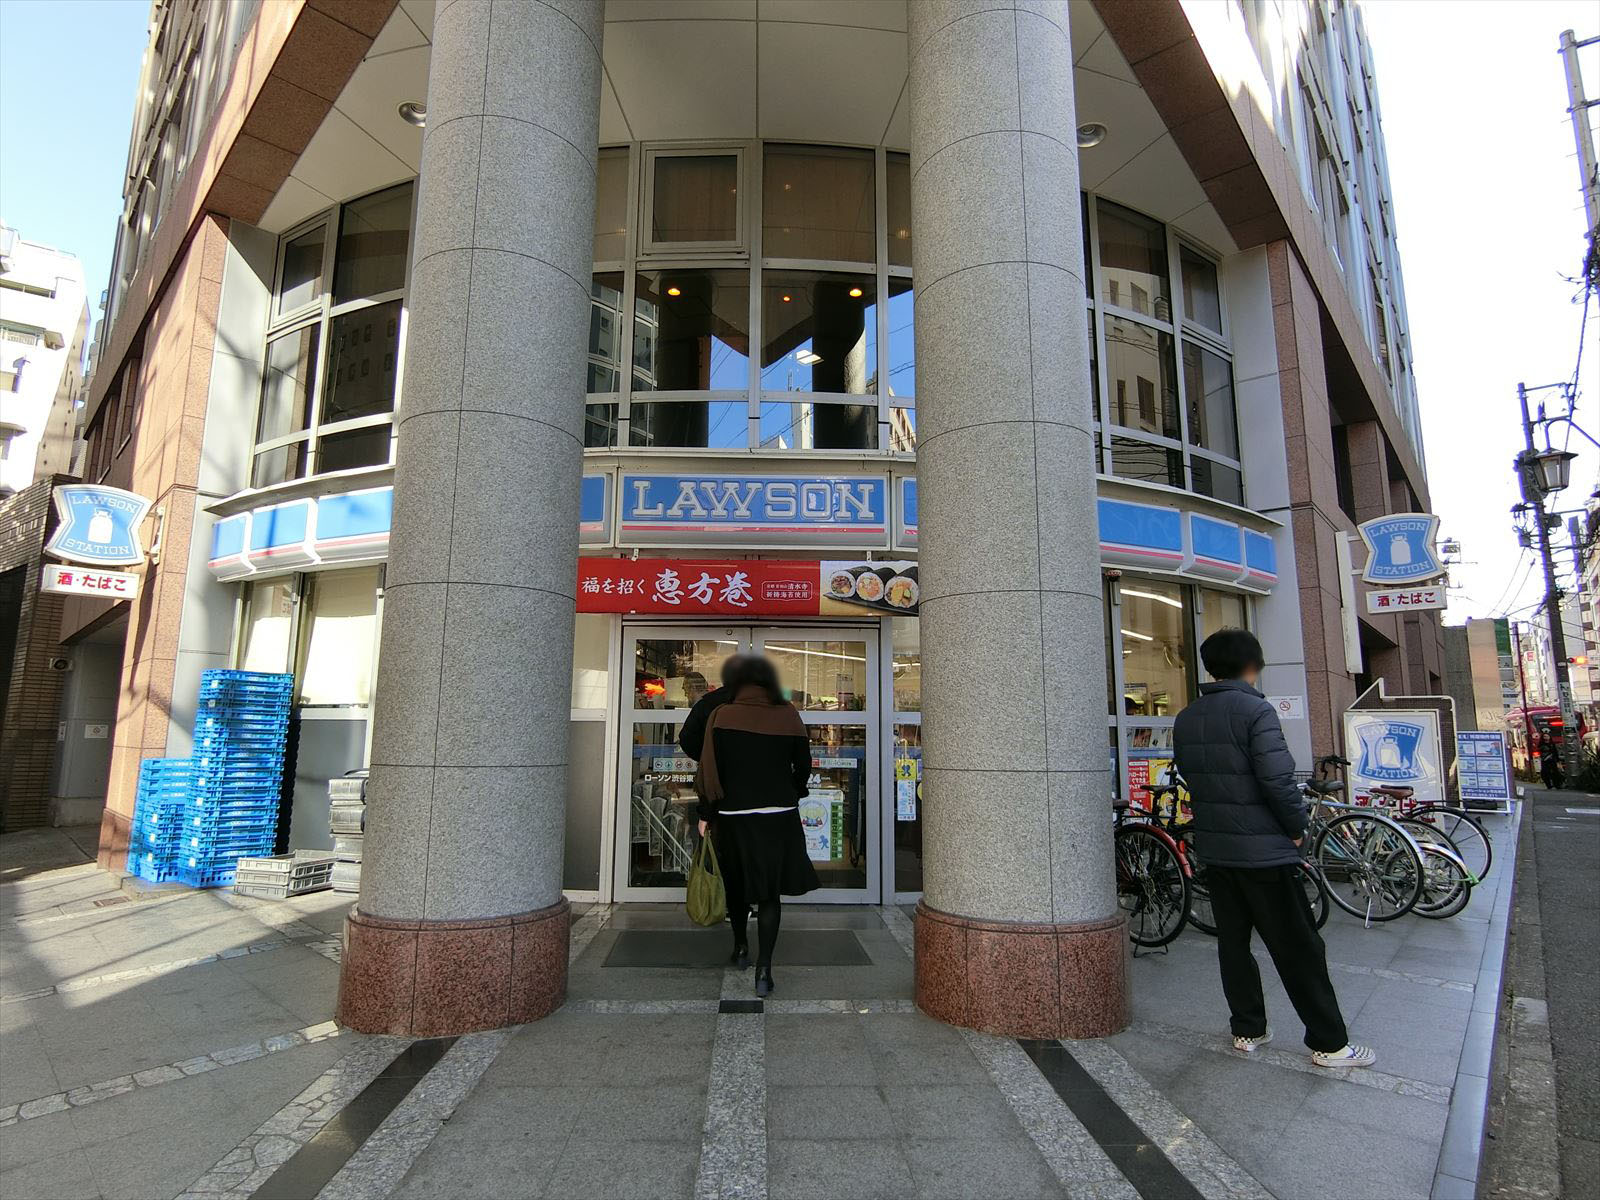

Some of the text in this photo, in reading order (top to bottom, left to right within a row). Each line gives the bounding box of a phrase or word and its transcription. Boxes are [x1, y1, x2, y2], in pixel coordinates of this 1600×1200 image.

[71, 495, 139, 514] LAWSON
[631, 479, 875, 521] LAWSON
[1369, 521, 1427, 537] LAWSON
[64, 538, 130, 555] STATION
[1374, 560, 1432, 575] STATION
[57, 571, 127, 592] 酒・たばこ
[581, 568, 753, 608] 福を招く 恵方巻
[1377, 592, 1436, 607] 酒・たばこ
[1361, 724, 1418, 738] LAWSON
[1364, 766, 1419, 779] STATION
